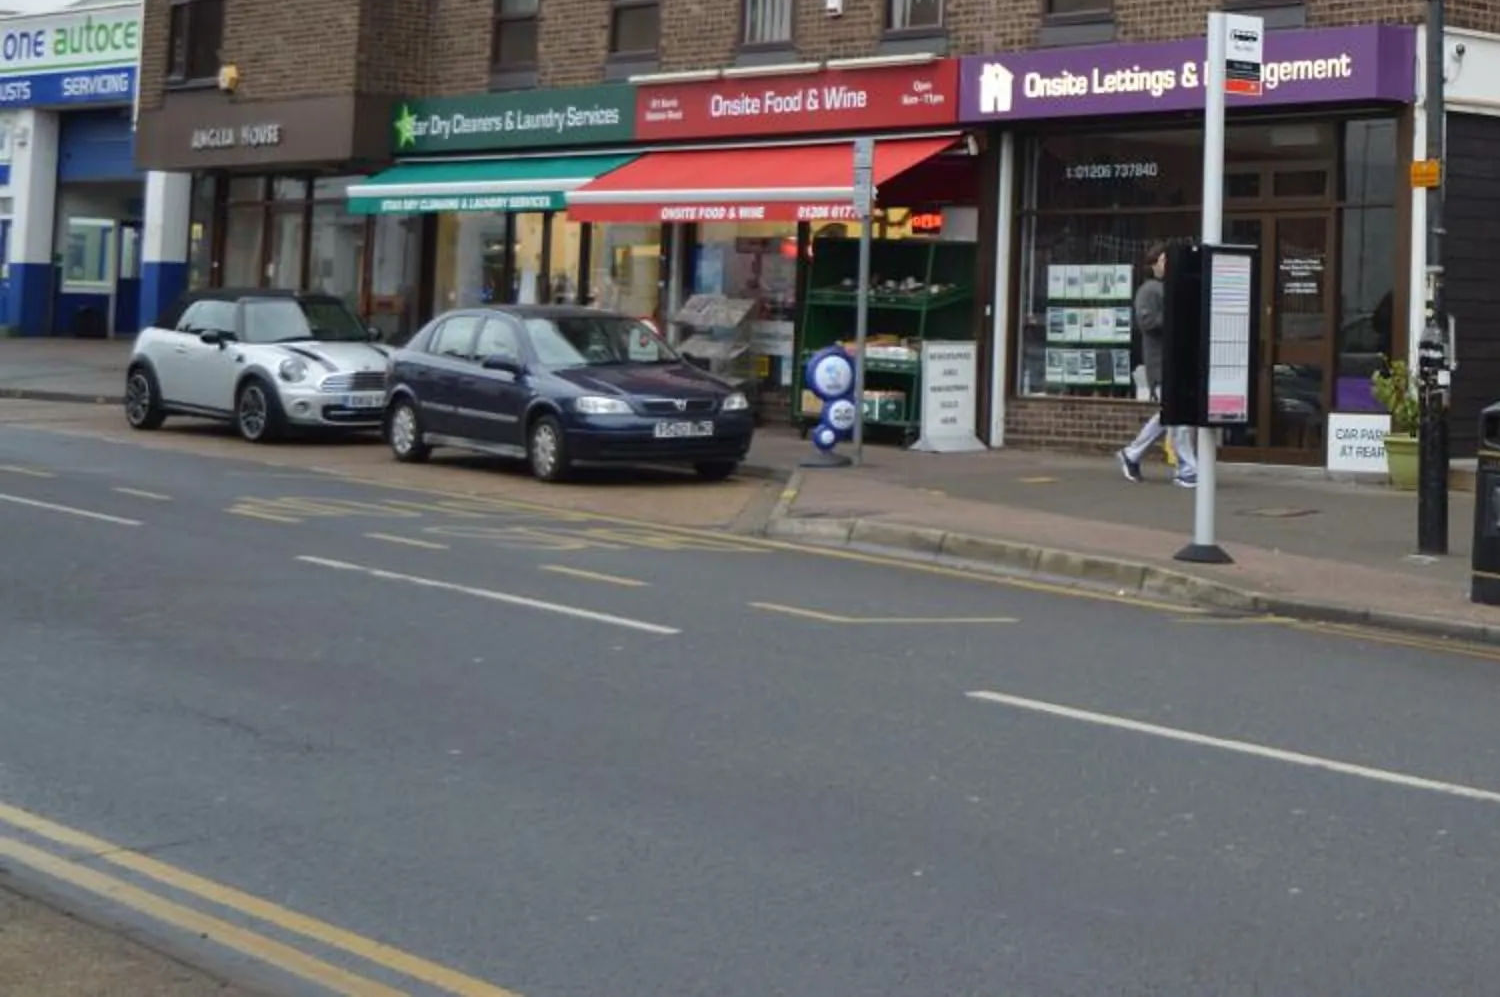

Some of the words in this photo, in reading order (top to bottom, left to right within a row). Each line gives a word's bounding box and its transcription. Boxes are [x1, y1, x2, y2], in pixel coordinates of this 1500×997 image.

[3, 29, 45, 60] one
[53, 14, 138, 55] autoce
[63, 72, 129, 97] SERVICING
[1024, 69, 1088, 99] Onsite
[1092, 65, 1175, 97] Lettings
[1181, 62, 1199, 88] &
[1204, 54, 1352, 90] gement
[711, 92, 761, 117] Onsite
[764, 90, 802, 114] Food
[806, 88, 820, 111] &
[824, 85, 867, 110] Wine
[431, 114, 450, 139] Dry
[505, 110, 514, 132] &
[517, 107, 565, 134] Laundry
[567, 104, 619, 127] Services
